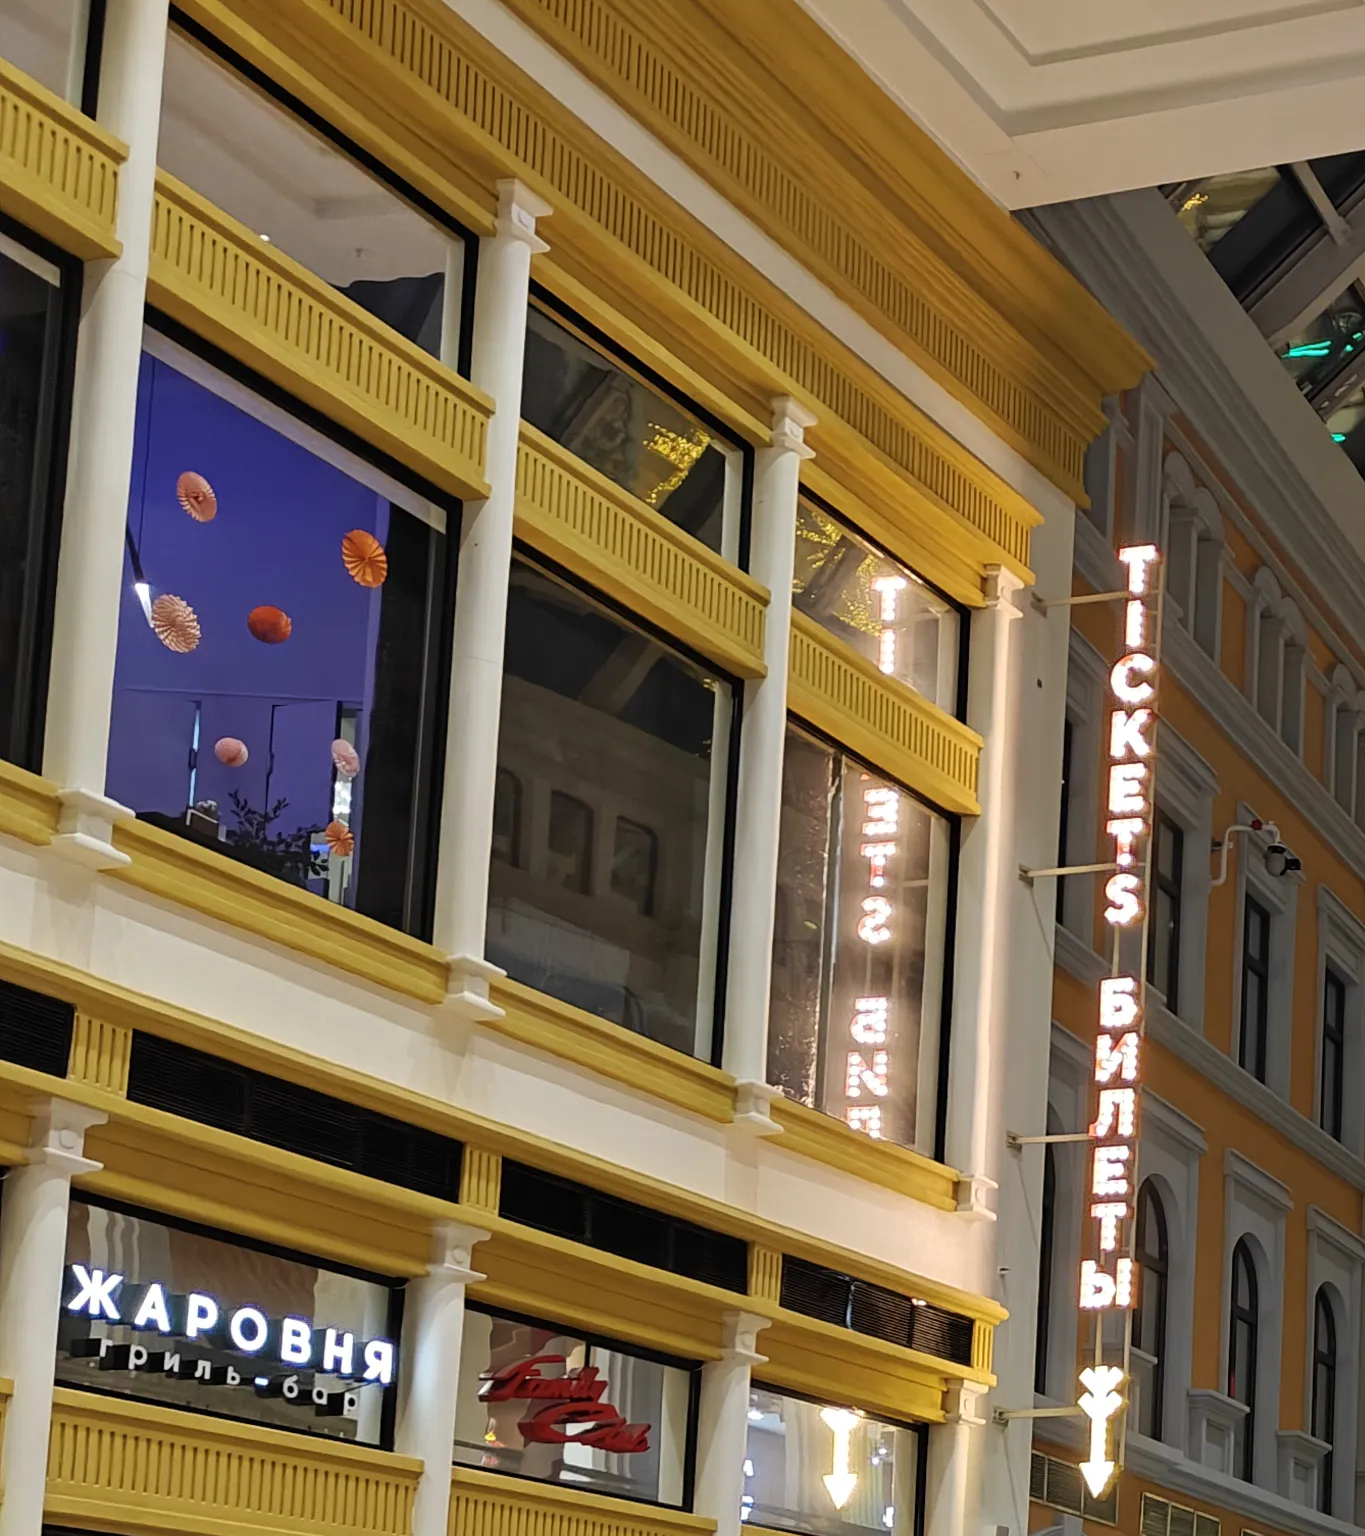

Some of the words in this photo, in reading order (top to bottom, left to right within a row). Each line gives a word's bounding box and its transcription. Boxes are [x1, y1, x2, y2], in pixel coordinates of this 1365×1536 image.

[1103, 544, 1161, 927] TICKETS
[1079, 976, 1140, 1309] БИЛЕТЫ
[67, 1264, 394, 1384] ЖАРОВНЯ
[99, 1338, 358, 1415] гриль-бар
